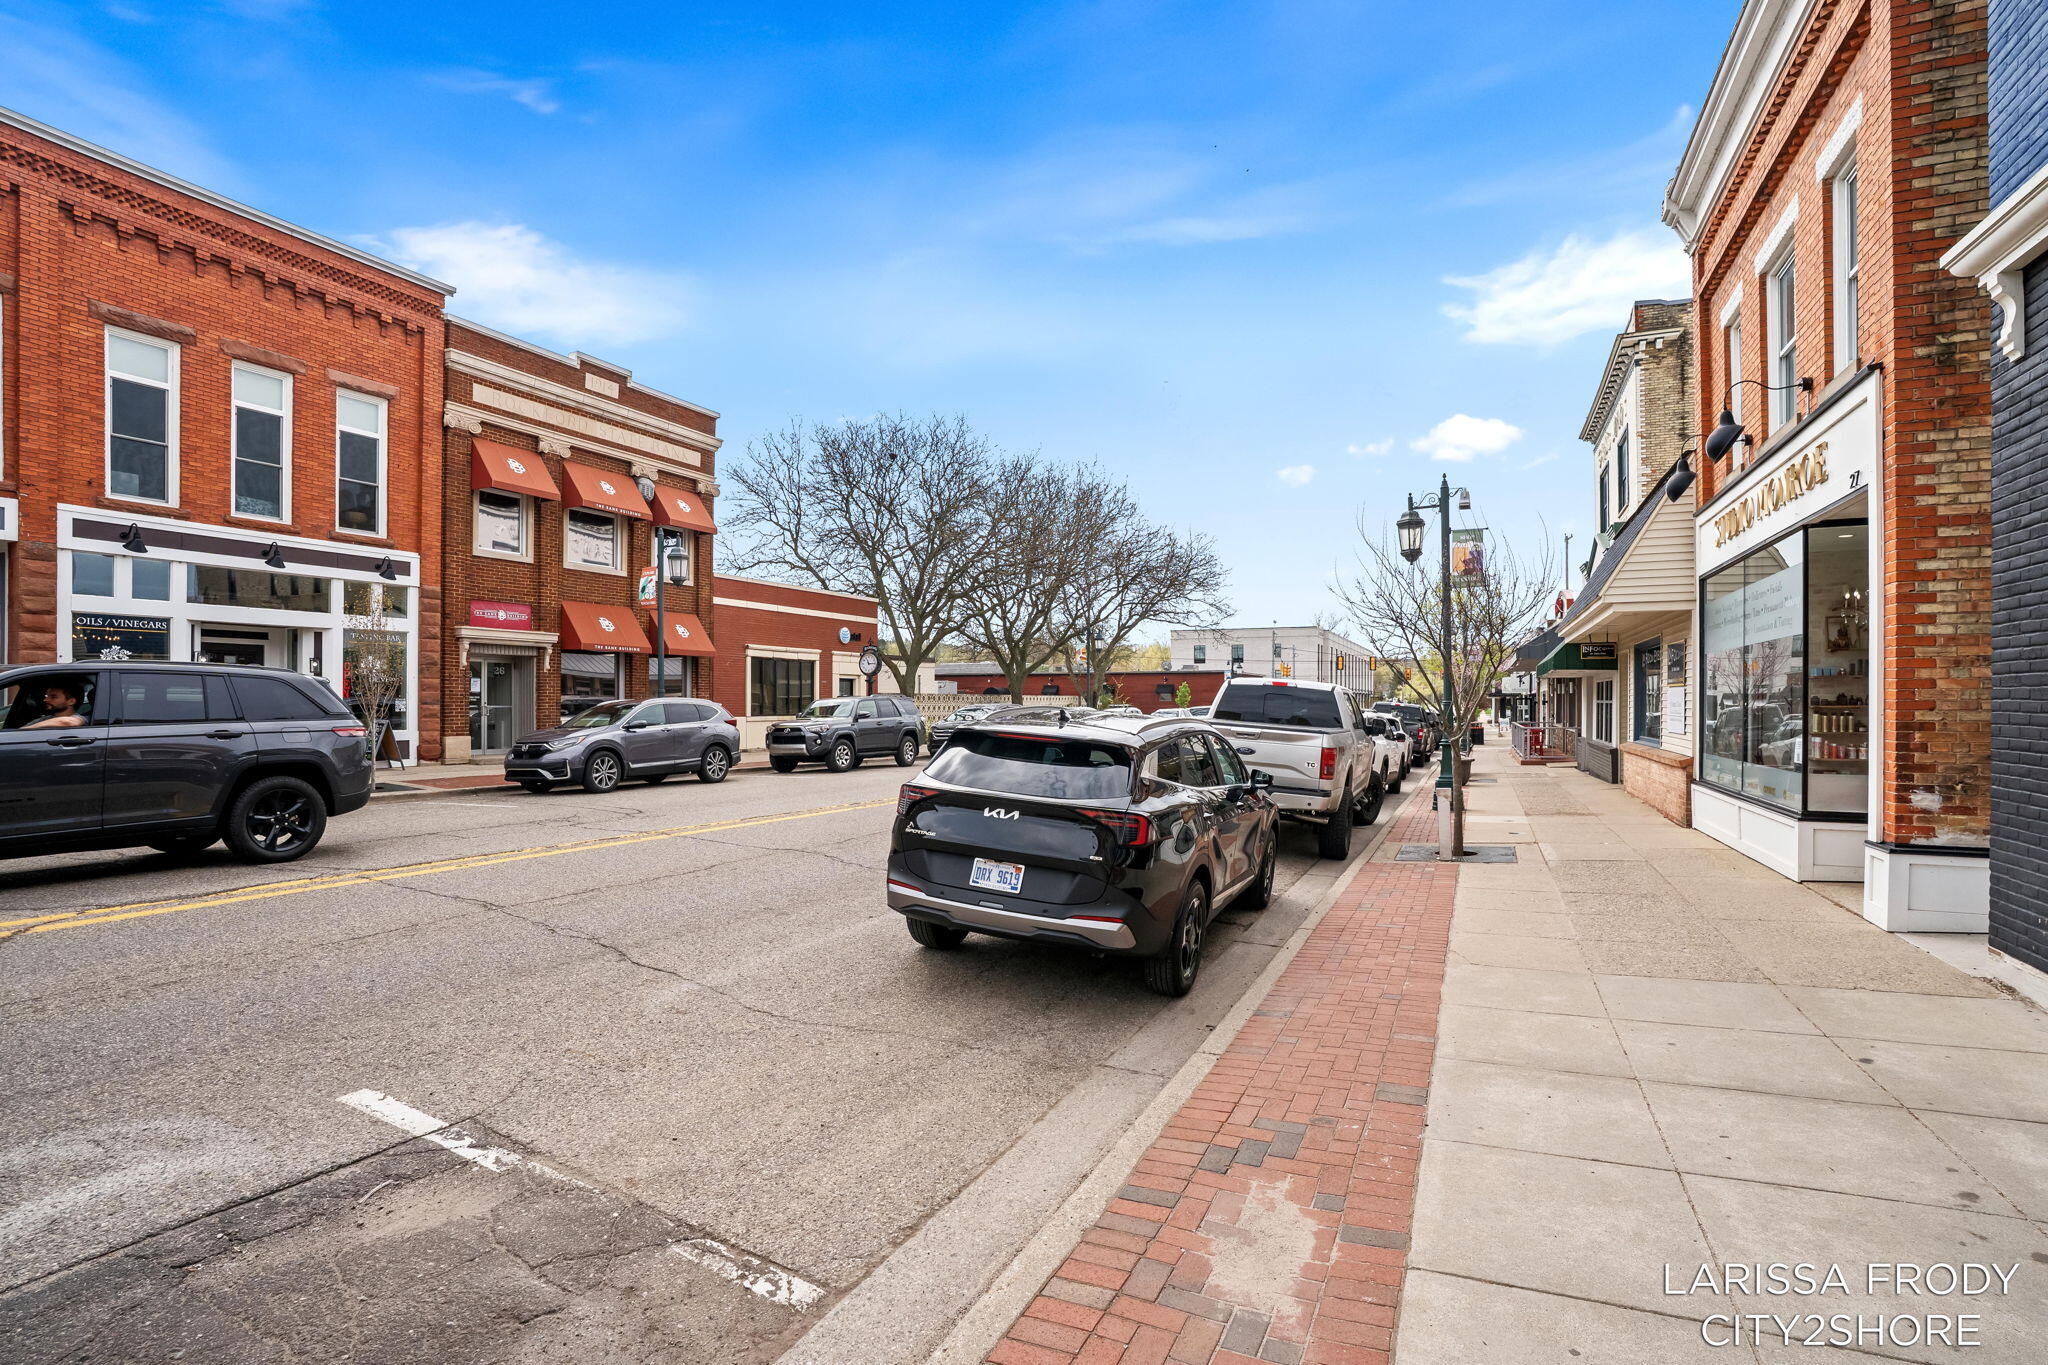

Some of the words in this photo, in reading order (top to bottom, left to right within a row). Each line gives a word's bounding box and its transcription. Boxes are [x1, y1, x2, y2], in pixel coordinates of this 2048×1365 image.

[492, 391, 589, 432] ROCKFORD
[600, 425, 643, 449] STATE
[653, 437, 689, 462] BANK
[1849, 470, 1860, 489] 27
[1714, 495, 1755, 548] STUDIO
[1756, 441, 1829, 521] MONROE
[76, 616, 103, 626] OILS
[112, 618, 168, 629] VINEGARS
[343, 661, 351, 699] OPEN
[493, 666, 505, 675] 26
[983, 806, 1020, 821] KIA
[975, 866, 991, 882] DRX
[996, 869, 1021, 886] 9619
